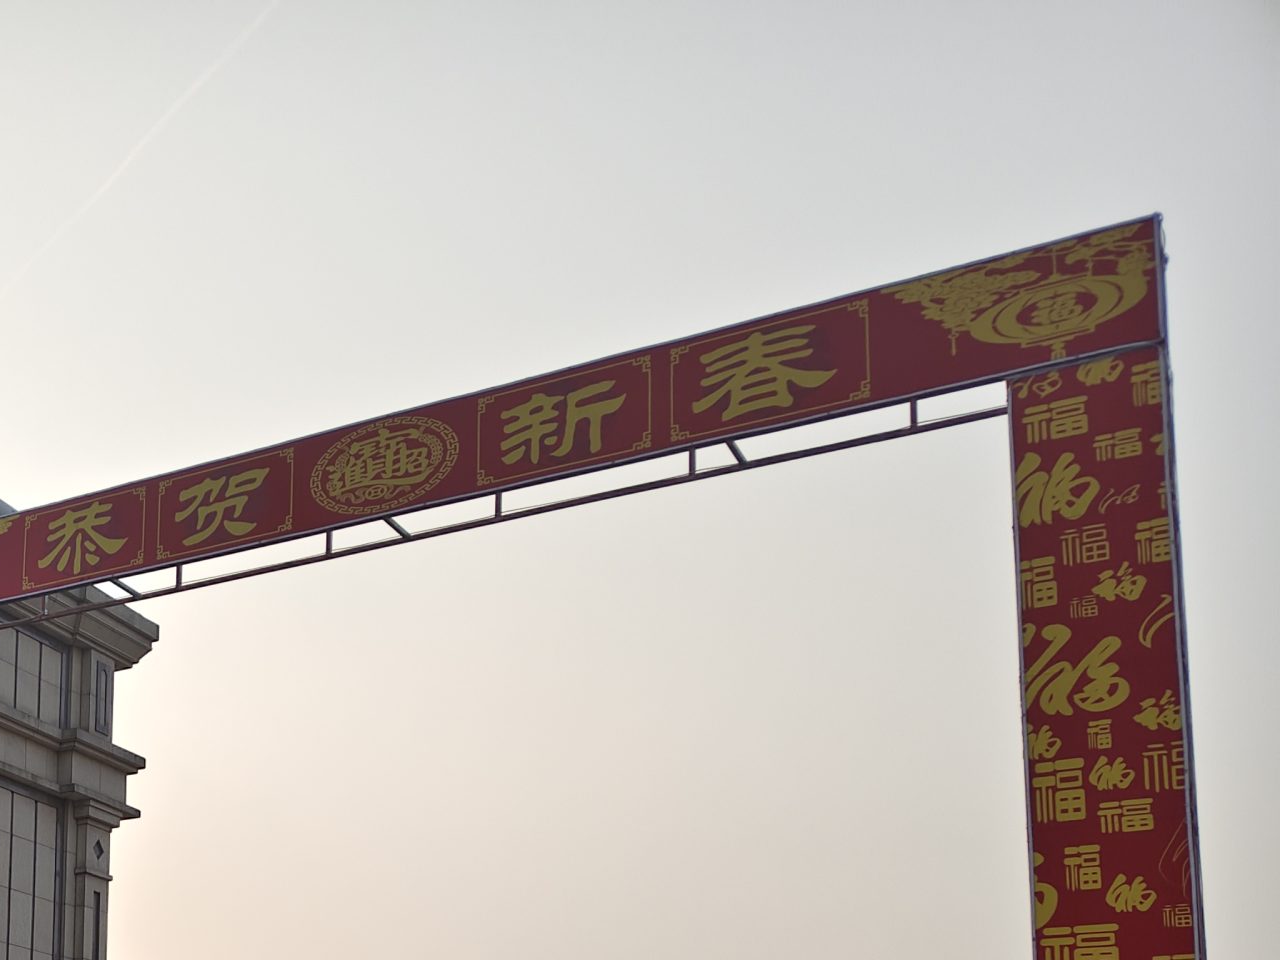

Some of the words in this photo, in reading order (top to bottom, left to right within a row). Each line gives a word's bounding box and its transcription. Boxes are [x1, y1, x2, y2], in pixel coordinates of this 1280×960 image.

[1022, 395, 1088, 444] 福
[1093, 428, 1143, 462] 福
[1032, 757, 1087, 824] 福
[1097, 798, 1154, 834] 福
[1063, 844, 1102, 892] 福
